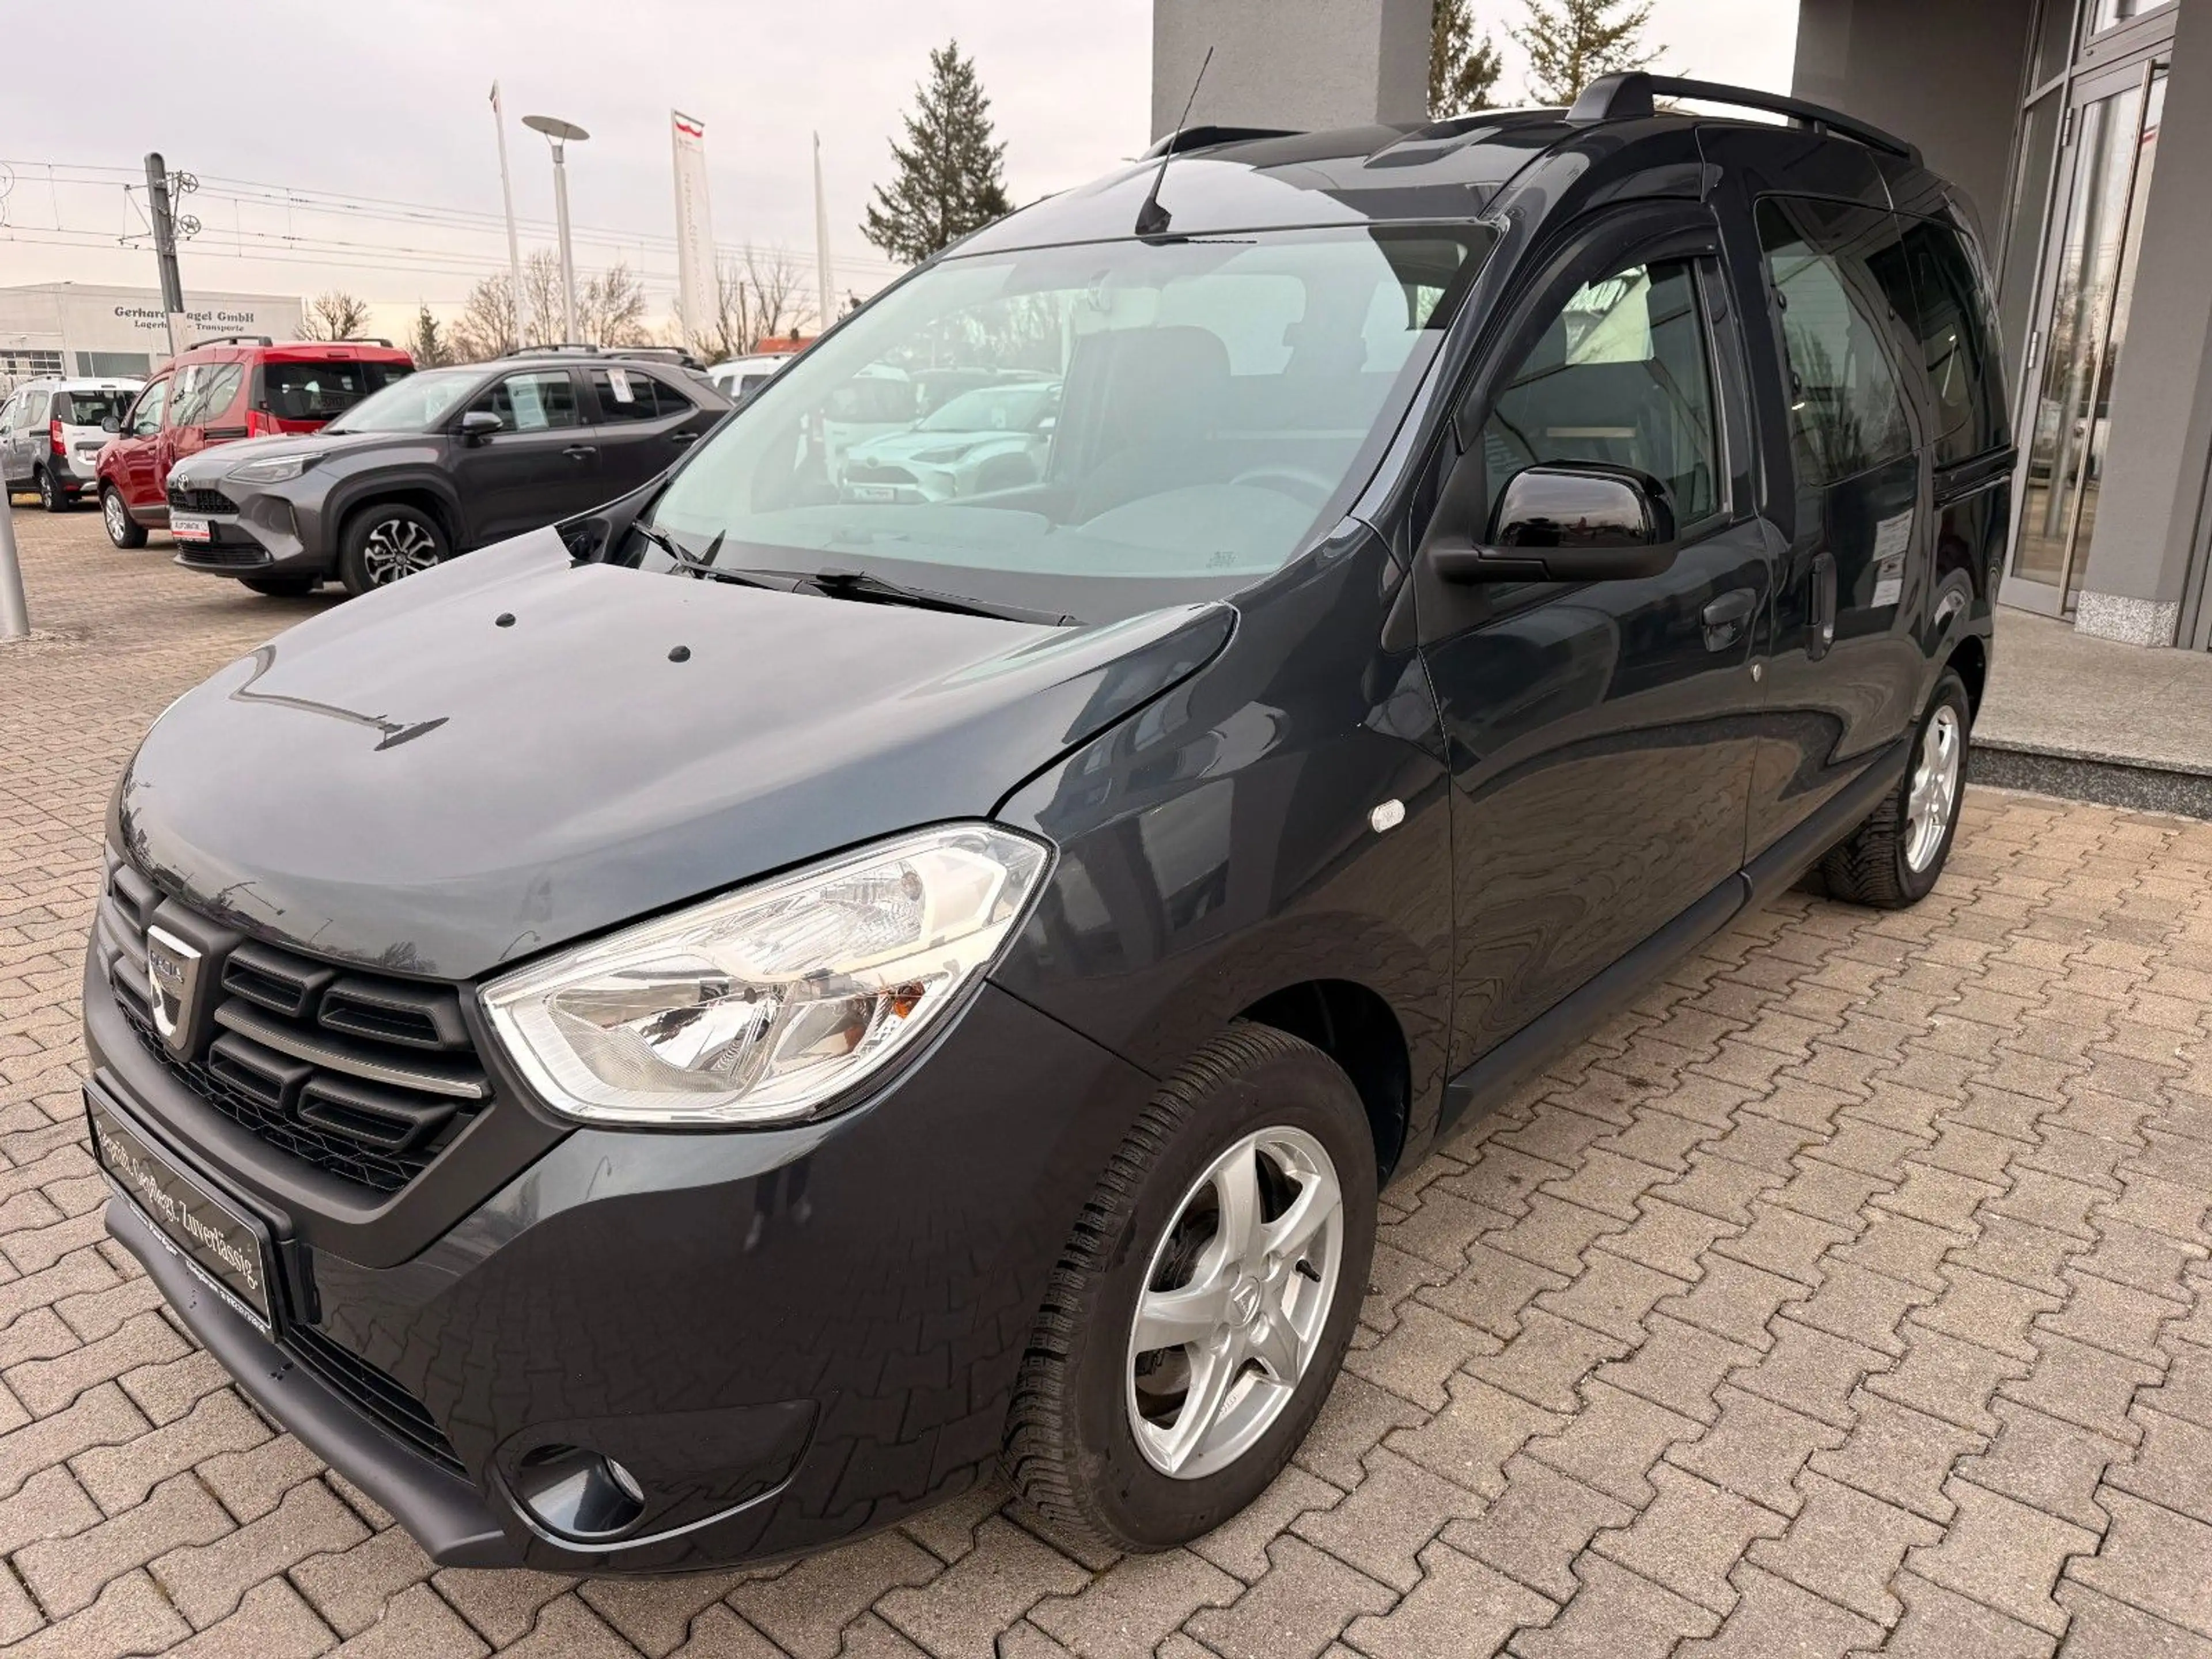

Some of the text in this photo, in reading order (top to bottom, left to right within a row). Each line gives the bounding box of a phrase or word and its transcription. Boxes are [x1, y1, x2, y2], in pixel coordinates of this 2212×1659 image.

[186, 311, 212, 321] agel
[217, 311, 254, 323] GmbH
[196, 323, 244, 332] Transporte
[150, 950, 185, 984] DACIA
[132, 1158, 179, 1222] Gepflegt.
[179, 1200, 258, 1290] Zuverlässig.
